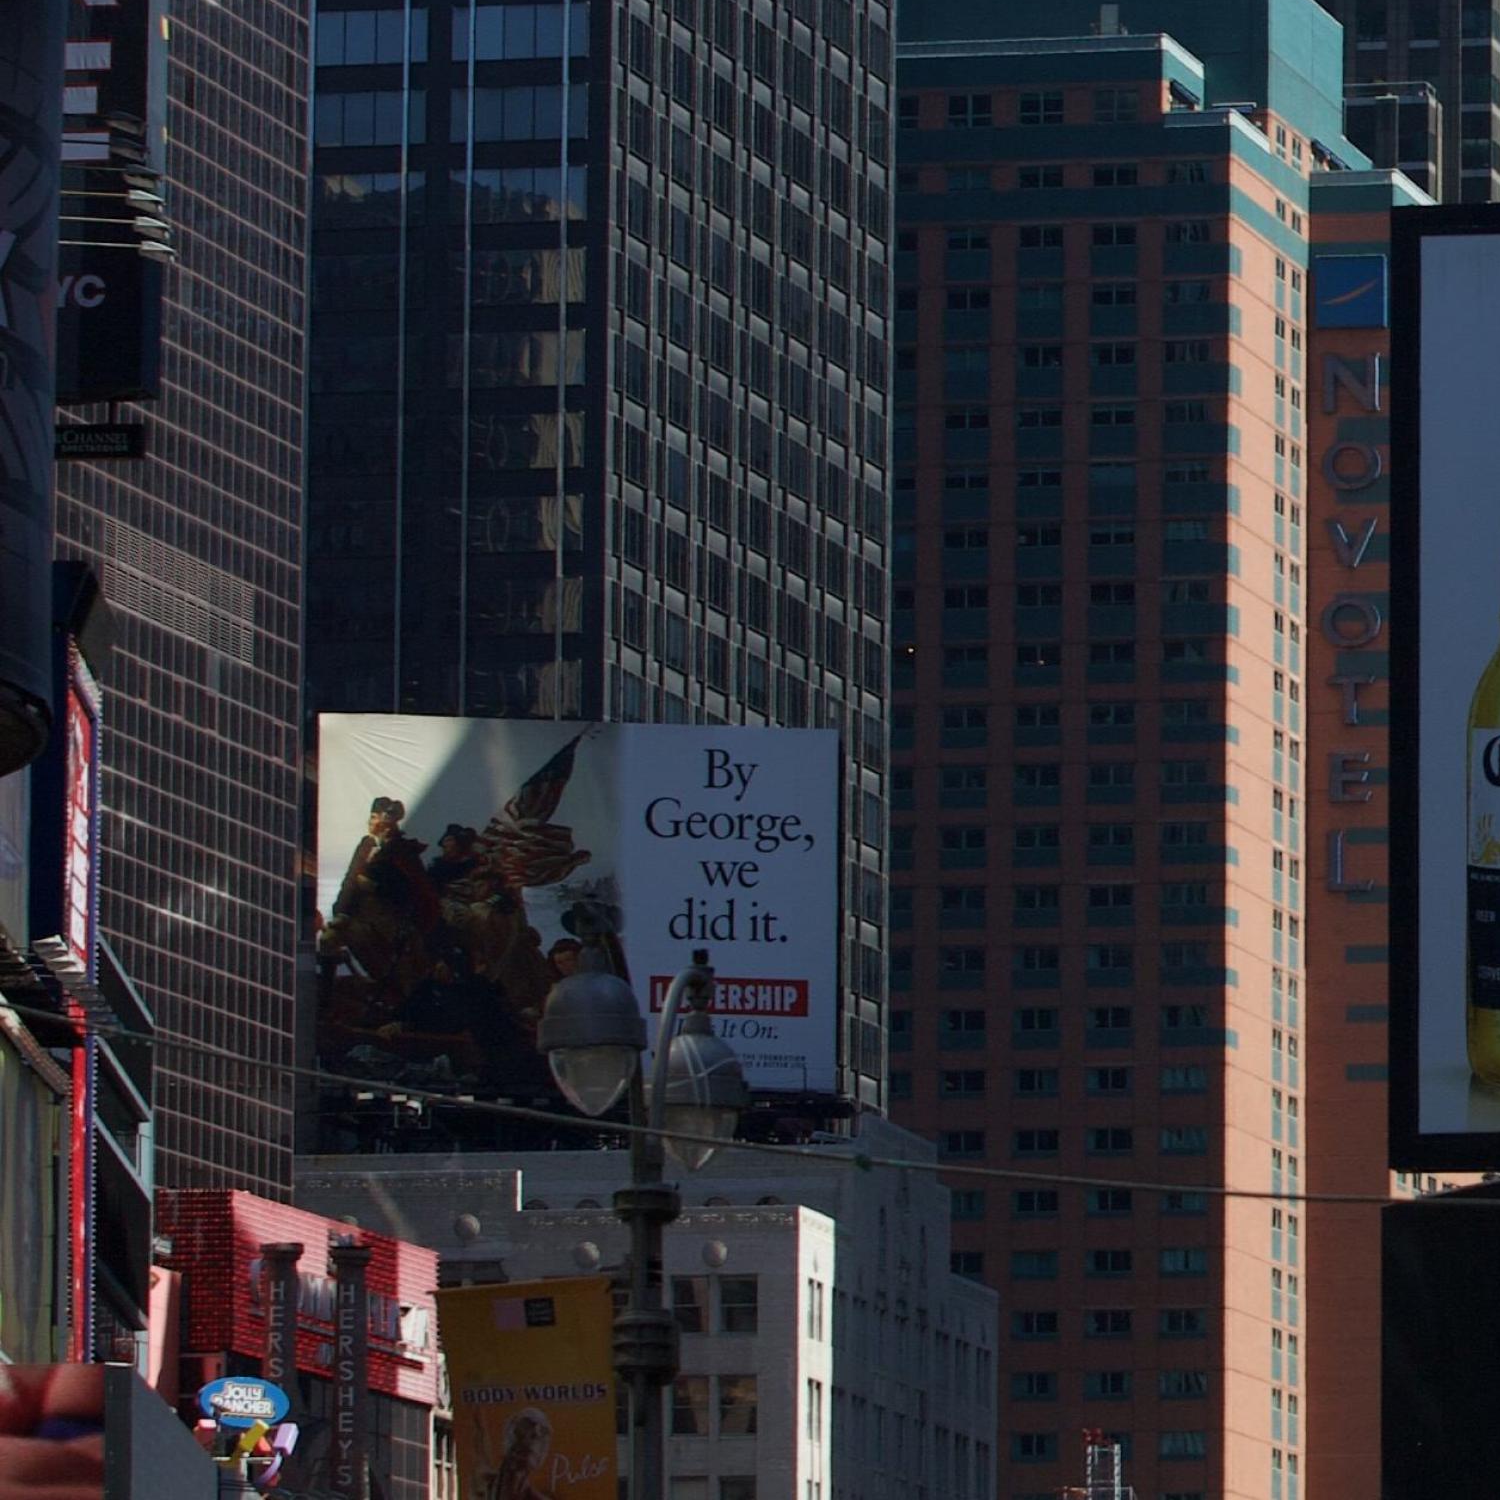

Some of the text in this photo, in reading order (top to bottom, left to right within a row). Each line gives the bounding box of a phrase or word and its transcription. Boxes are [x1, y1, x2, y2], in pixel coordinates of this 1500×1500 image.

[1322, 352, 1382, 893] NOVOTEL
[704, 749, 759, 801] By
[645, 796, 815, 853] George,
[699, 861, 760, 888] we
[669, 897, 787, 943] did it.
[720, 1019, 736, 1038] It
[740, 1019, 779, 1040] On.
[462, 1383, 607, 1402] BODY WORLDS
